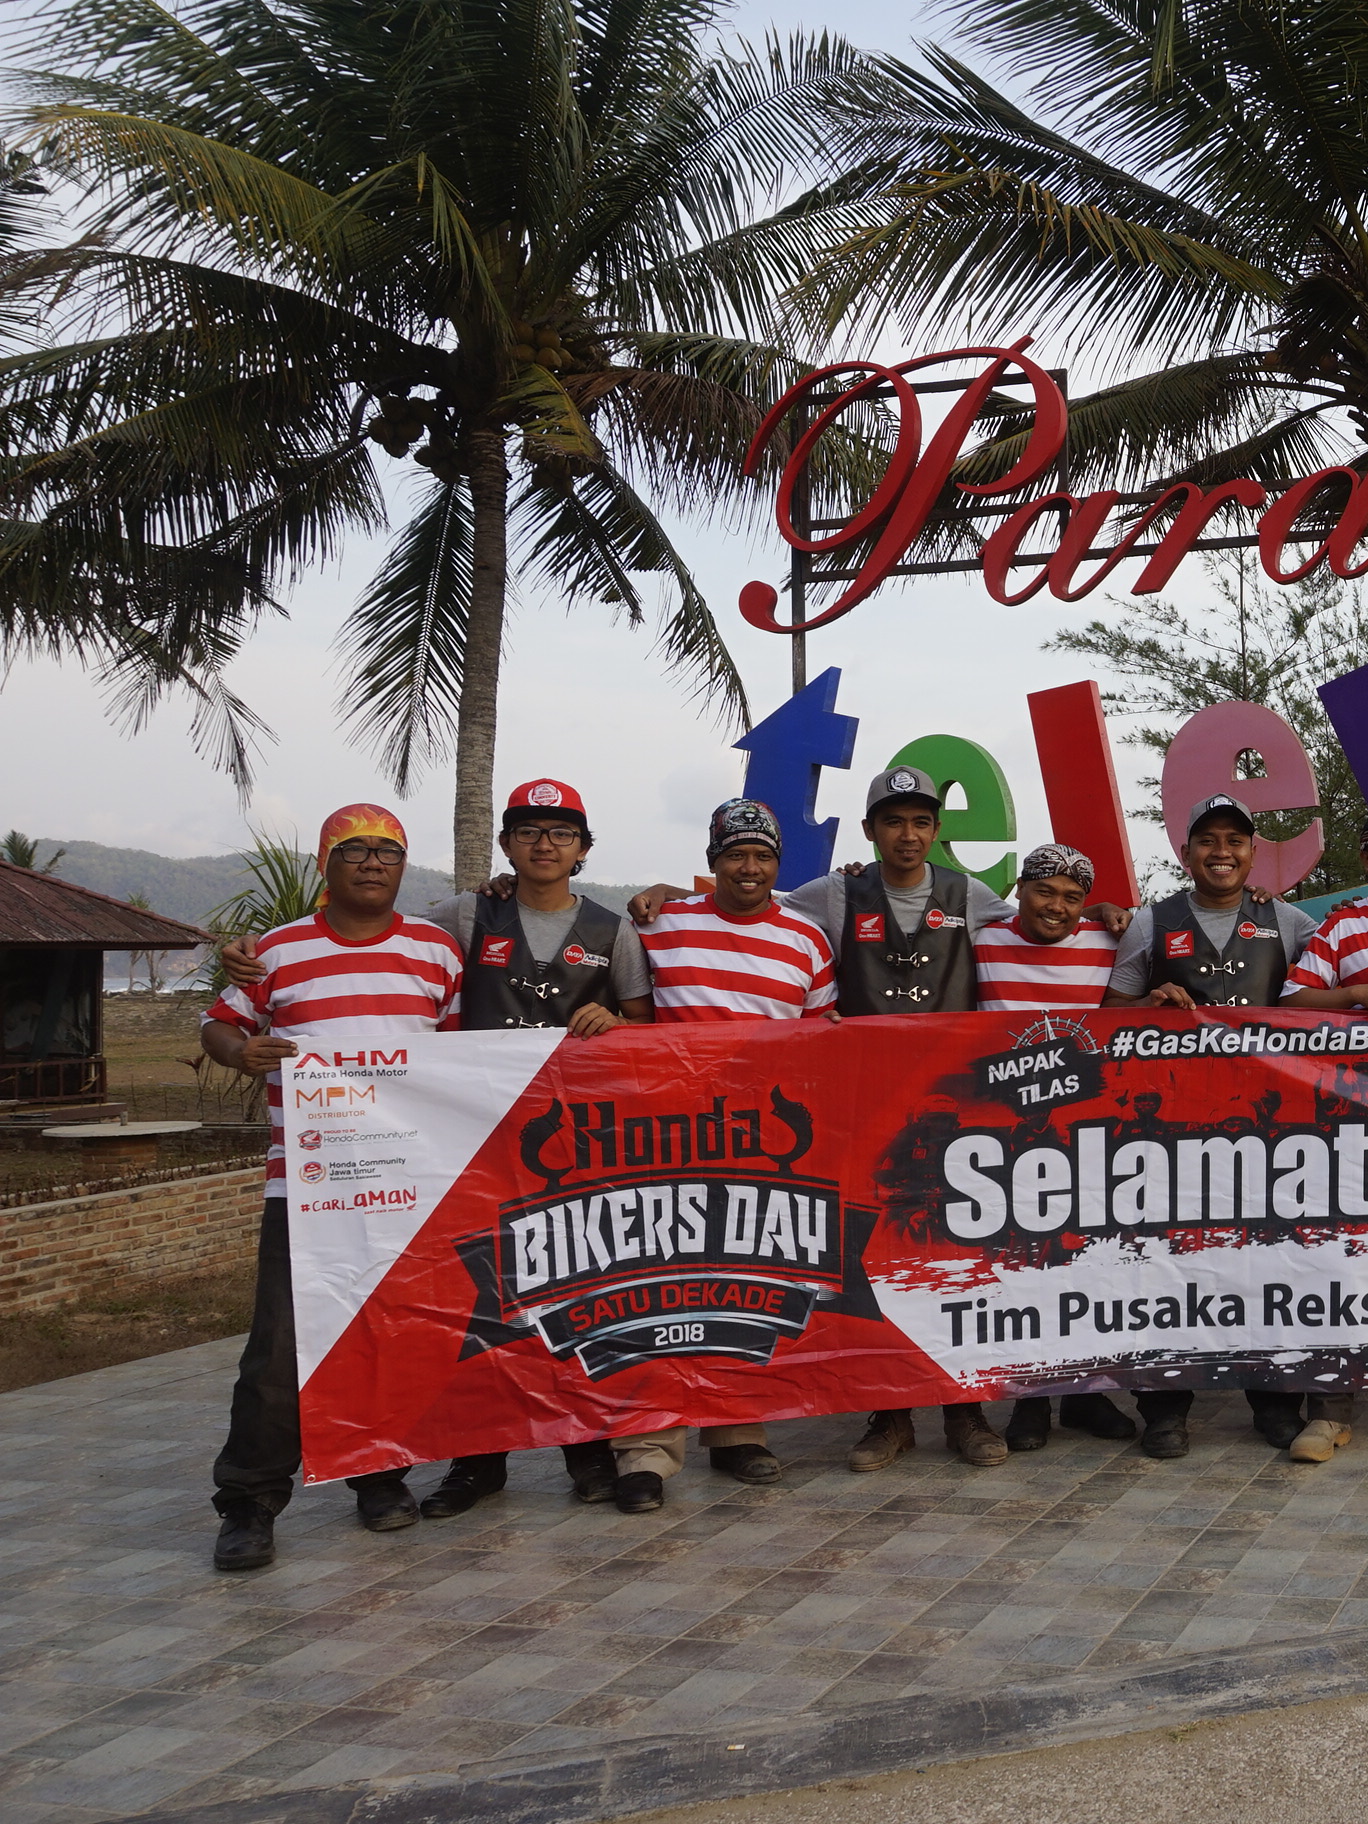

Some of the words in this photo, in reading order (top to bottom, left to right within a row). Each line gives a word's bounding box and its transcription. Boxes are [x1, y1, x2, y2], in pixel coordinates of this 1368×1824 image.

[294, 1049, 408, 1069] AHM
[988, 1047, 1066, 1083] NAPAK
[293, 1071, 306, 1080] PT
[309, 1071, 336, 1080] Astra
[340, 1069, 373, 1078] Honda
[376, 1068, 408, 1077] Motor
[1017, 1074, 1080, 1106] TILAS
[308, 1110, 366, 1120] DISTRIBUTOR
[323, 1129, 418, 1144] HondaCommunity.net
[567, 1096, 760, 1170] Honda
[329, 1161, 356, 1169] Honda
[359, 1157, 406, 1167] Community
[329, 1168, 351, 1177] Jawa
[354, 1167, 376, 1175] timur
[509, 1183, 708, 1294] BIKERS
[724, 1184, 827, 1265] DAY
[568, 1287, 651, 1332] SATU
[661, 1282, 787, 1314] DEKADE
[941, 1297, 1041, 1347] Tim
[1059, 1282, 1246, 1336] Pusaka
[654, 1323, 705, 1346] 2018
